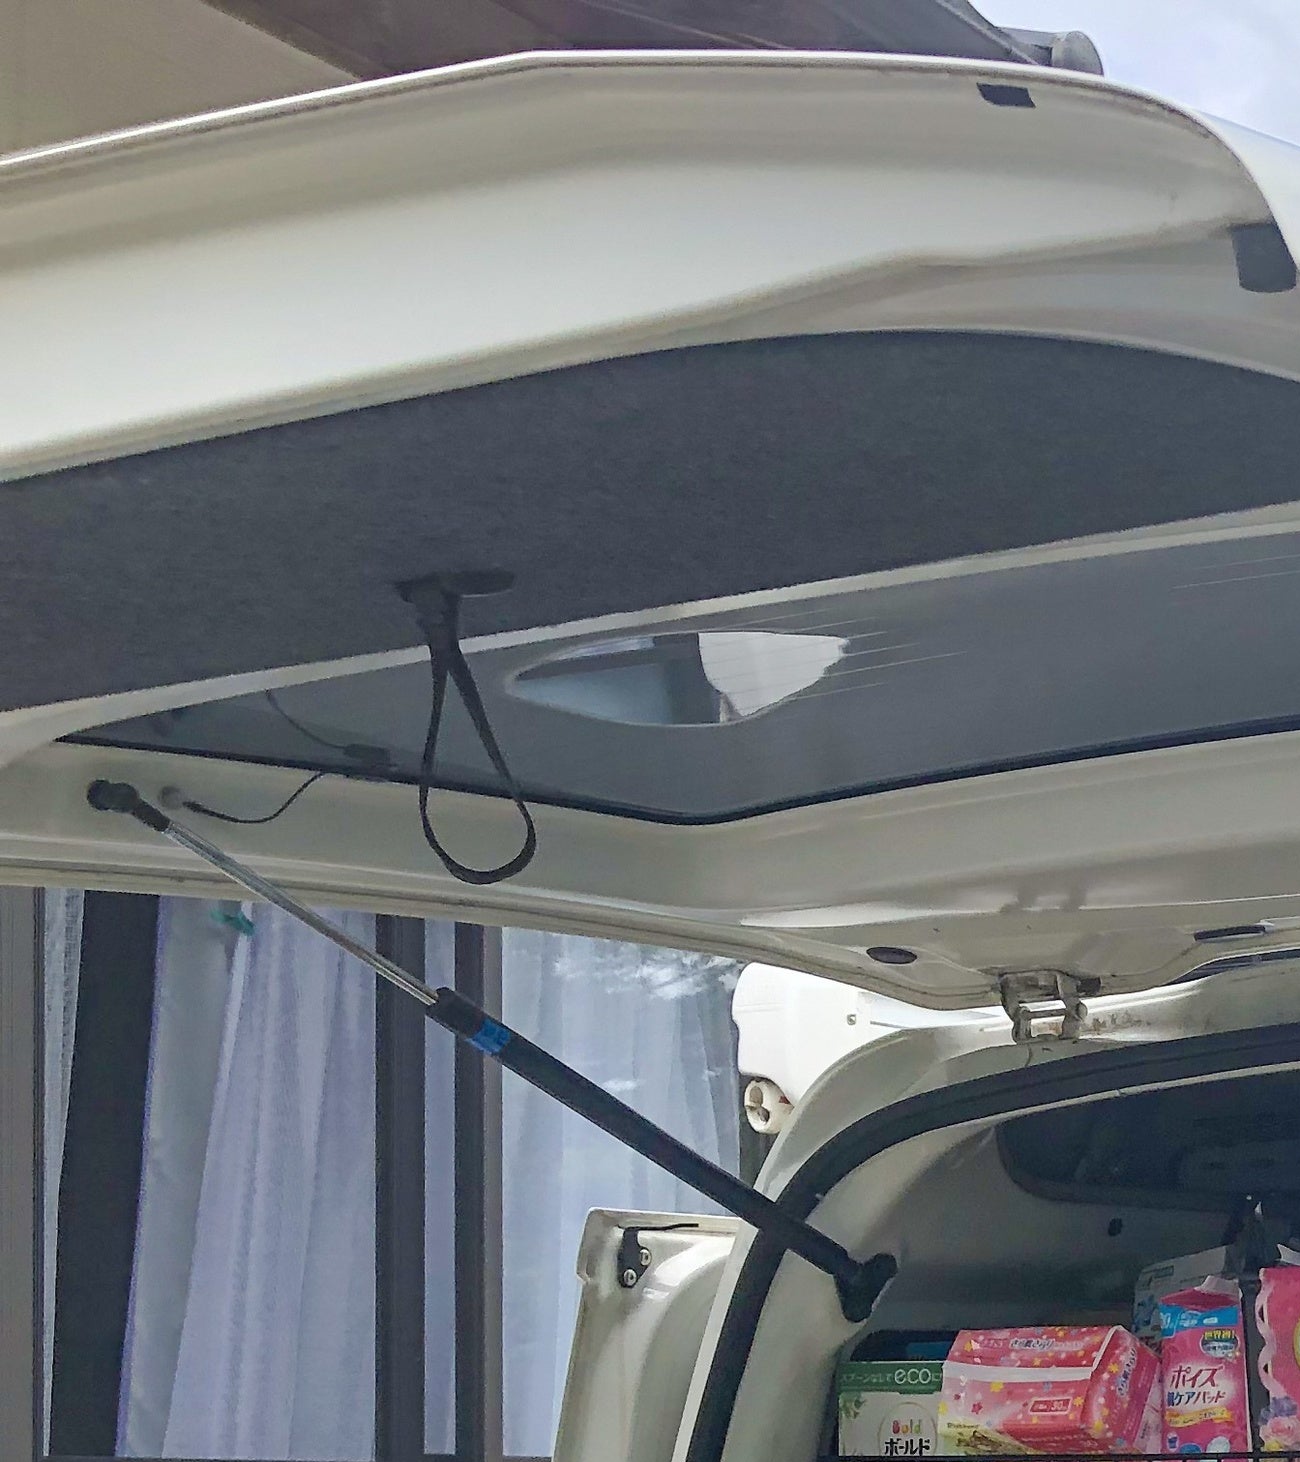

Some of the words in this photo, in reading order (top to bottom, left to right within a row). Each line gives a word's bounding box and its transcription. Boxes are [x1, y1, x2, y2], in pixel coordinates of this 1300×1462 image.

[1170, 1365, 1224, 1389] ポイズ
[884, 1437, 931, 1456] ボールド
